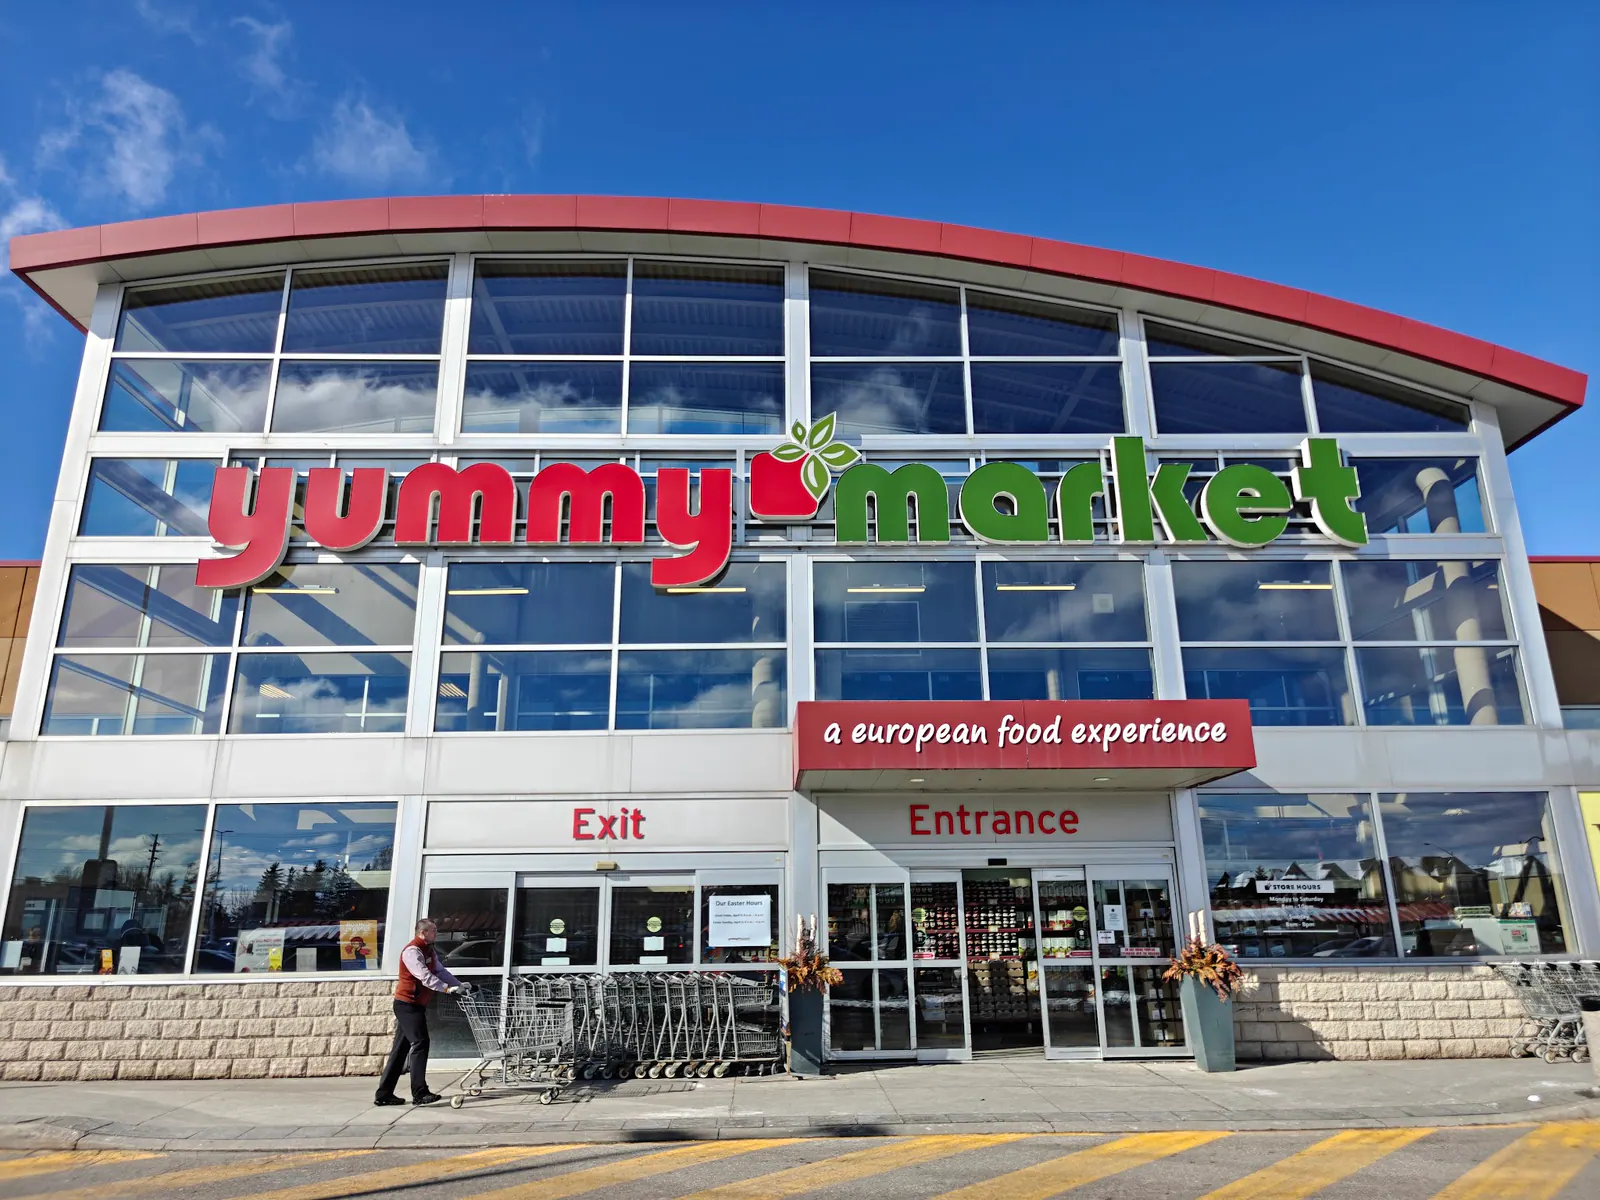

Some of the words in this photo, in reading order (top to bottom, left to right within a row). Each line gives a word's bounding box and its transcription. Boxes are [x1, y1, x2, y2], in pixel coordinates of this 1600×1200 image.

[195, 461, 733, 589] yummy
[833, 436, 1369, 549] market
[823, 722, 842, 745] a
[851, 719, 988, 753] european
[996, 714, 1062, 748] food
[1070, 717, 1228, 753] experience
[572, 807, 646, 840] Exit
[909, 803, 1079, 836] Entrance
[1269, 896, 1292, 904] Monday
